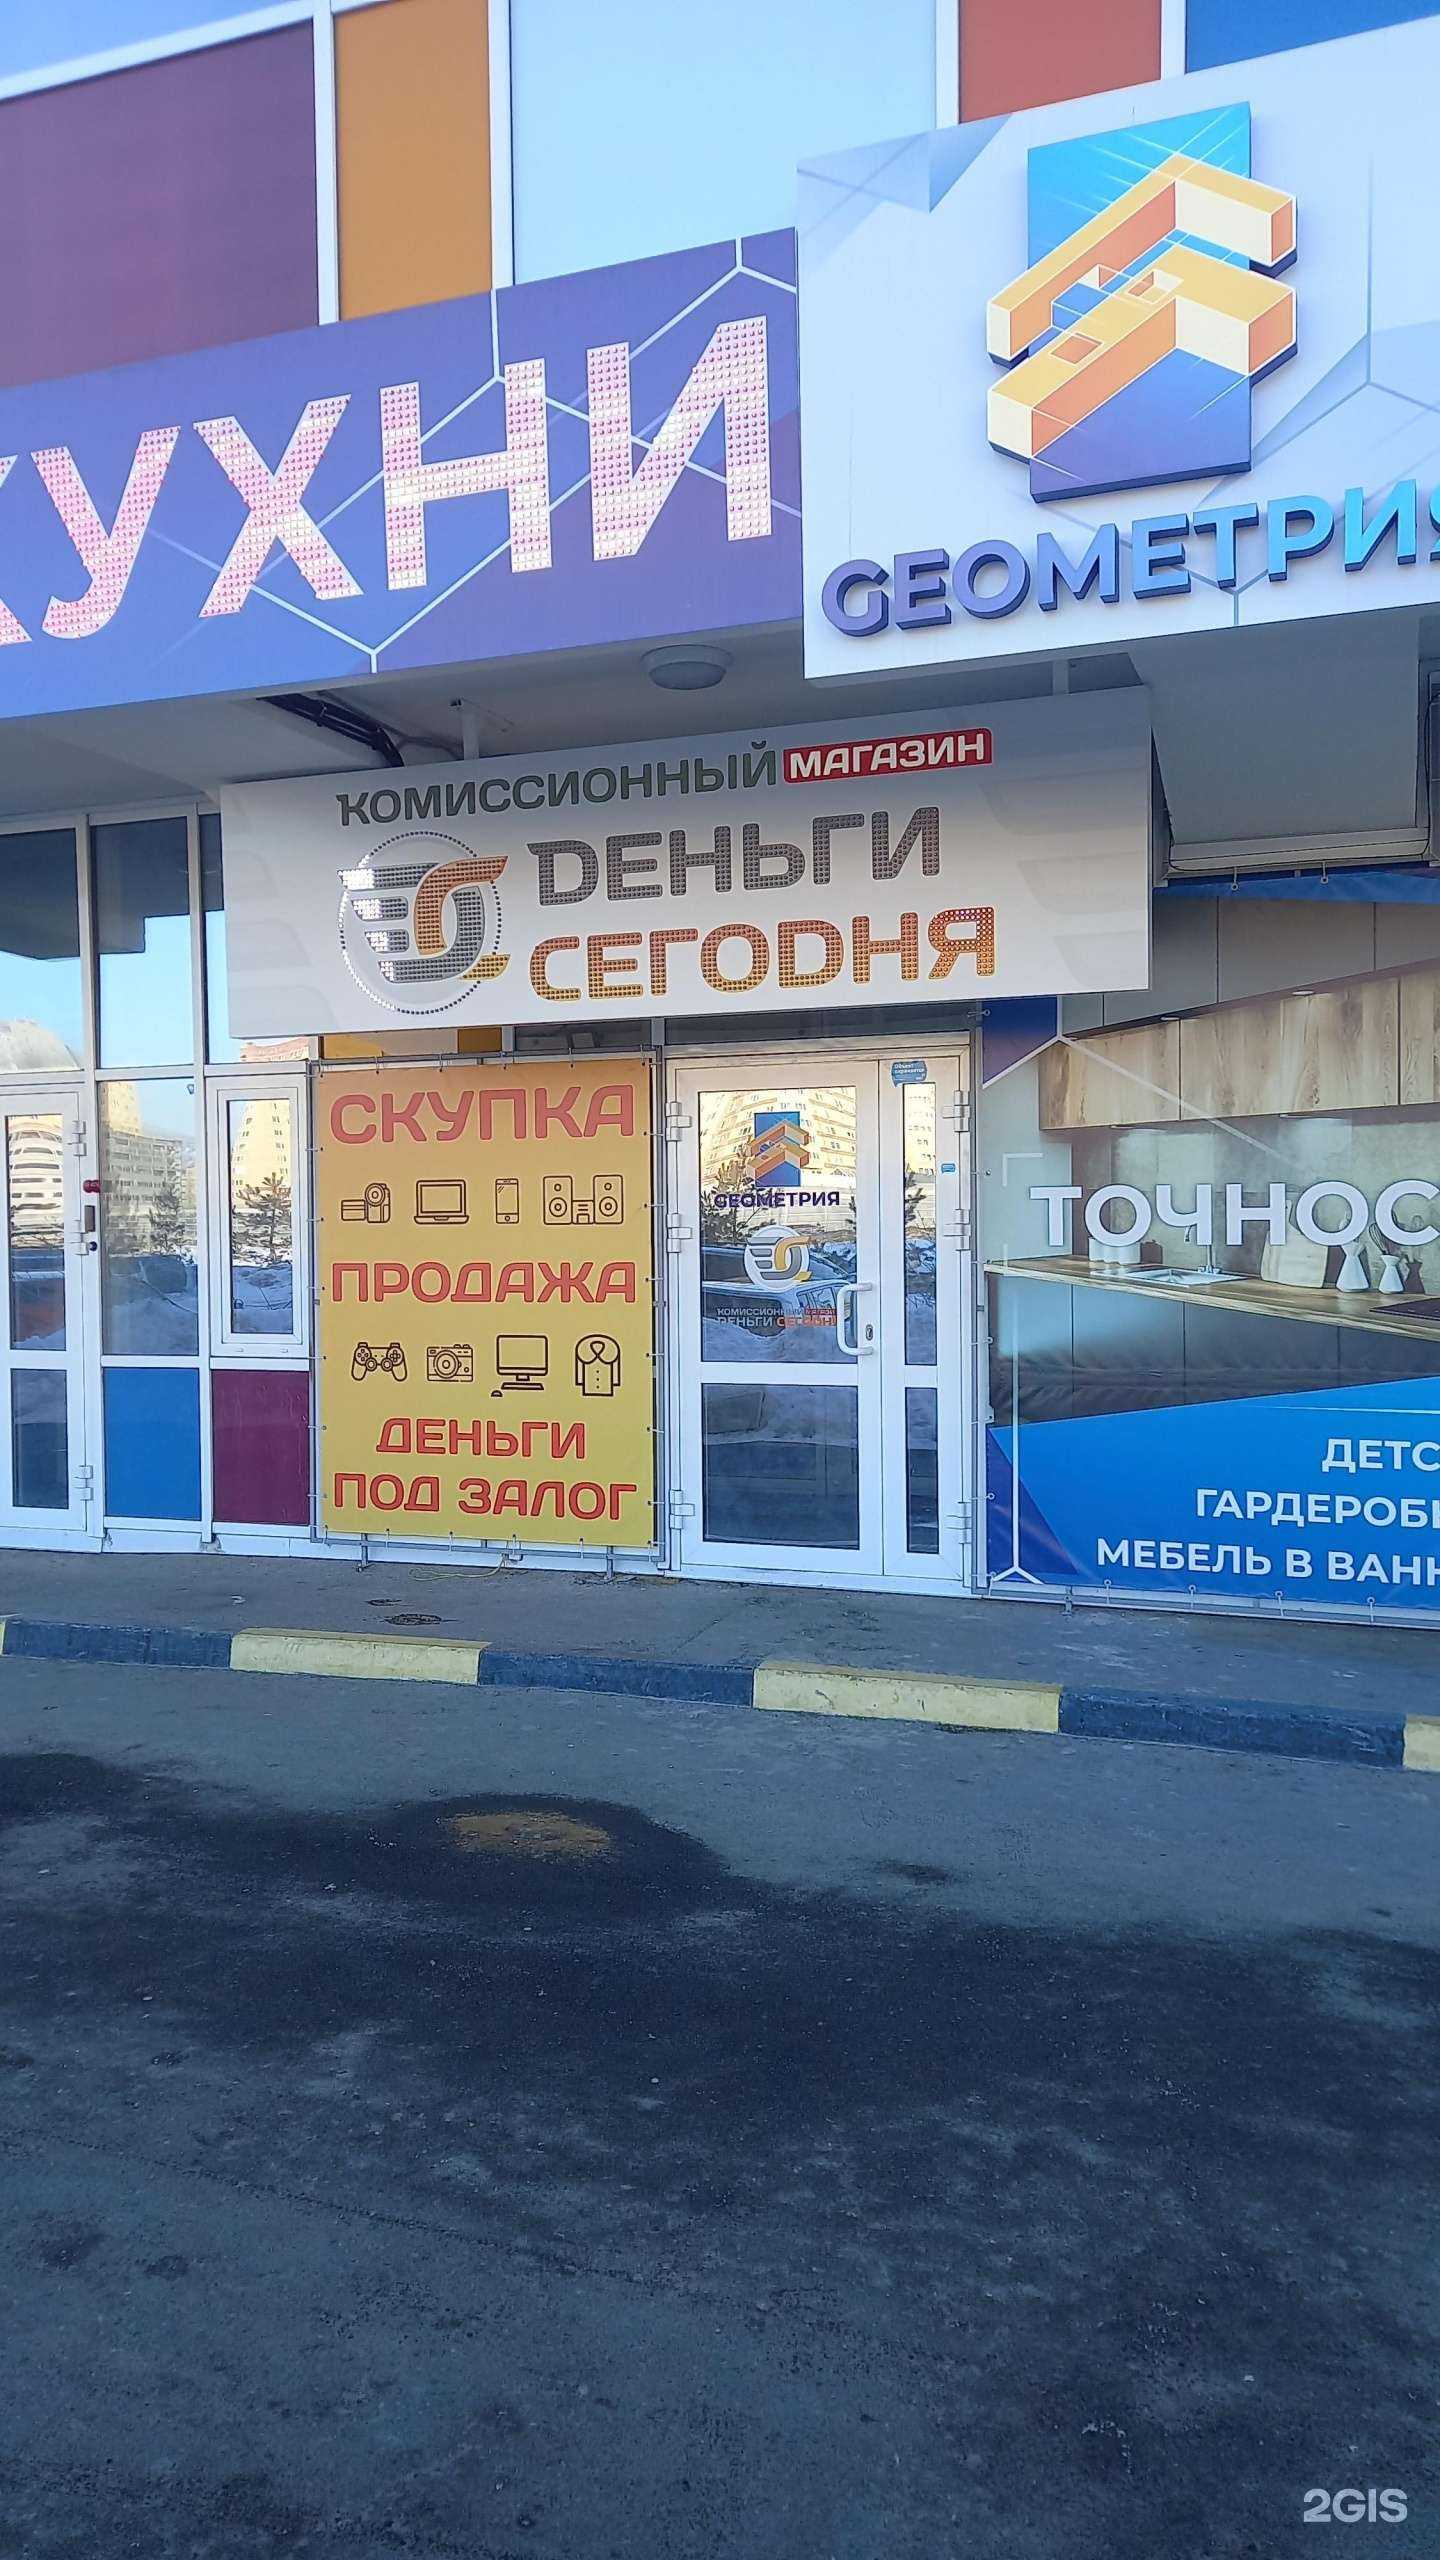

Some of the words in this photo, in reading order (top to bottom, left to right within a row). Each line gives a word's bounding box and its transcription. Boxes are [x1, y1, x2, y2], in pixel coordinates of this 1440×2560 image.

[821, 479, 1440, 637] GЕОМЕТРИ
[336, 740, 776, 827] КОМИССИОННЫЙ
[790, 733, 984, 780] МАГАЗИН
[330, 1085, 634, 1144] СКУПКА
[1030, 1179, 1440, 1248] ТОЧНОС
[331, 1262, 636, 1303] ПРОДАЖА
[376, 1418, 586, 1459] ДЕНЬГИ
[1321, 1438, 1440, 1474] ДЕТС
[334, 1473, 440, 1512] ПОД
[458, 1478, 637, 1520] ЗАЛОГ
[1196, 1489, 1440, 1529] ГАРДЕРОБ
[1097, 1538, 1272, 1576] МЕБЕЛЬ
[1286, 1549, 1313, 1579] В
